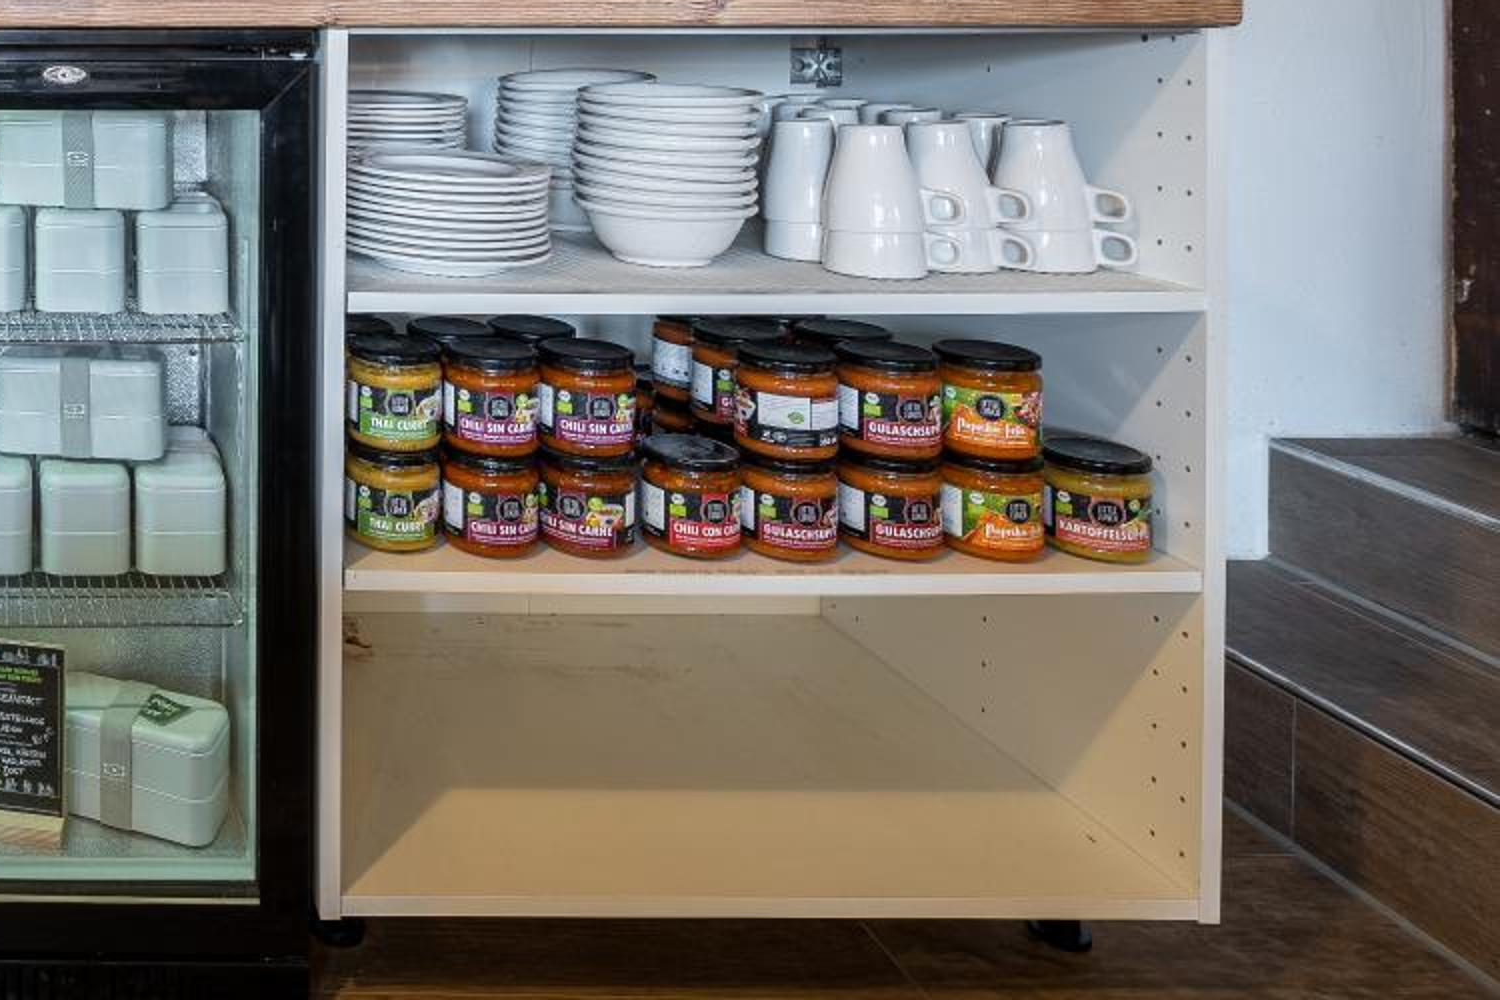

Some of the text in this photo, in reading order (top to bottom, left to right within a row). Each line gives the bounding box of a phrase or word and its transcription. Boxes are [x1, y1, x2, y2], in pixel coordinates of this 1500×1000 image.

[560, 419, 586, 432] CHILI
[589, 423, 607, 434] SIN
[499, 524, 517, 535] SIN
[673, 522, 699, 536] CHILI
[701, 526, 722, 537] CON
